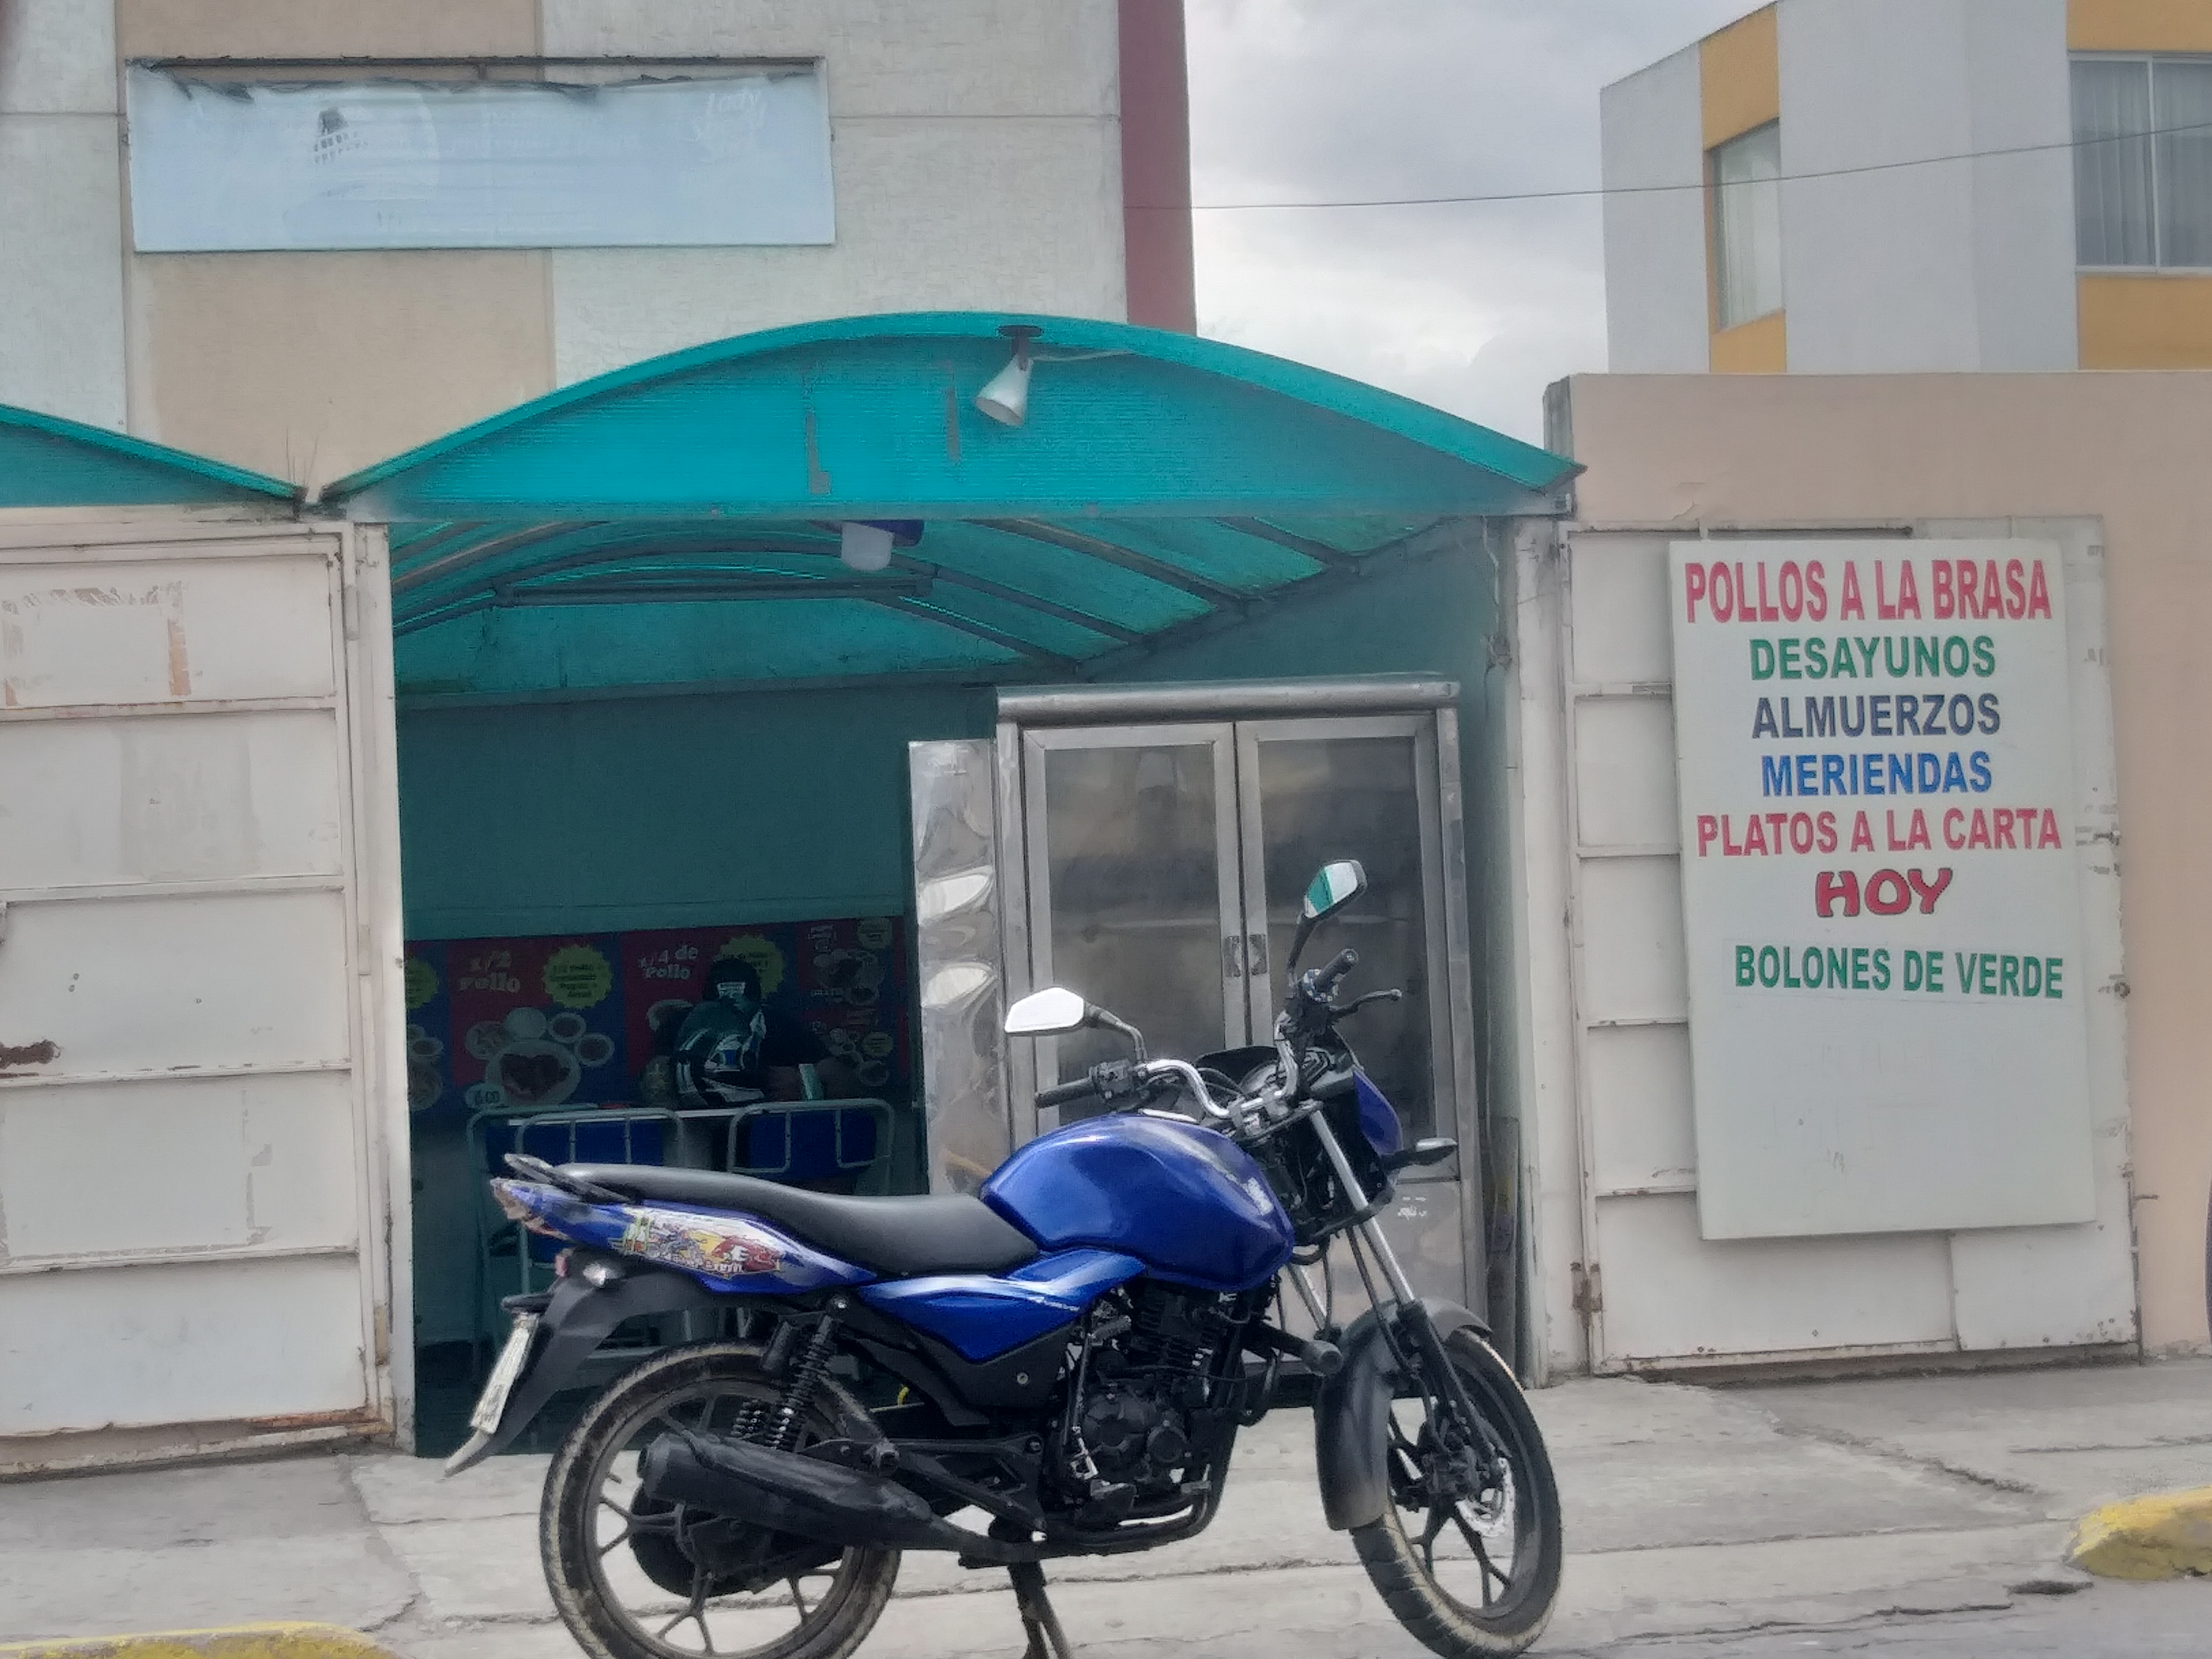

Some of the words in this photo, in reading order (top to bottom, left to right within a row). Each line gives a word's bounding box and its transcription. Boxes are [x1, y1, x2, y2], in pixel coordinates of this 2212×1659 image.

[1686, 561, 1827, 622] POLLOS
[1842, 562, 1863, 619] A
[1876, 561, 1920, 619] LA
[1933, 560, 2050, 619] BRASA
[1750, 636, 1995, 680] DESAYUNOS
[1753, 693, 2000, 738] ALMUERZOS
[1763, 751, 1992, 796] MERIENDAS
[1698, 812, 1838, 856] PLATOS
[1851, 811, 1874, 852] A
[1887, 809, 1931, 850] LA
[1944, 808, 2060, 849] CARTA
[1815, 868, 1953, 918] HOY
[1736, 946, 1891, 990] BOLONES
[1904, 950, 1943, 992] DE
[1956, 953, 2062, 998] VERDE
